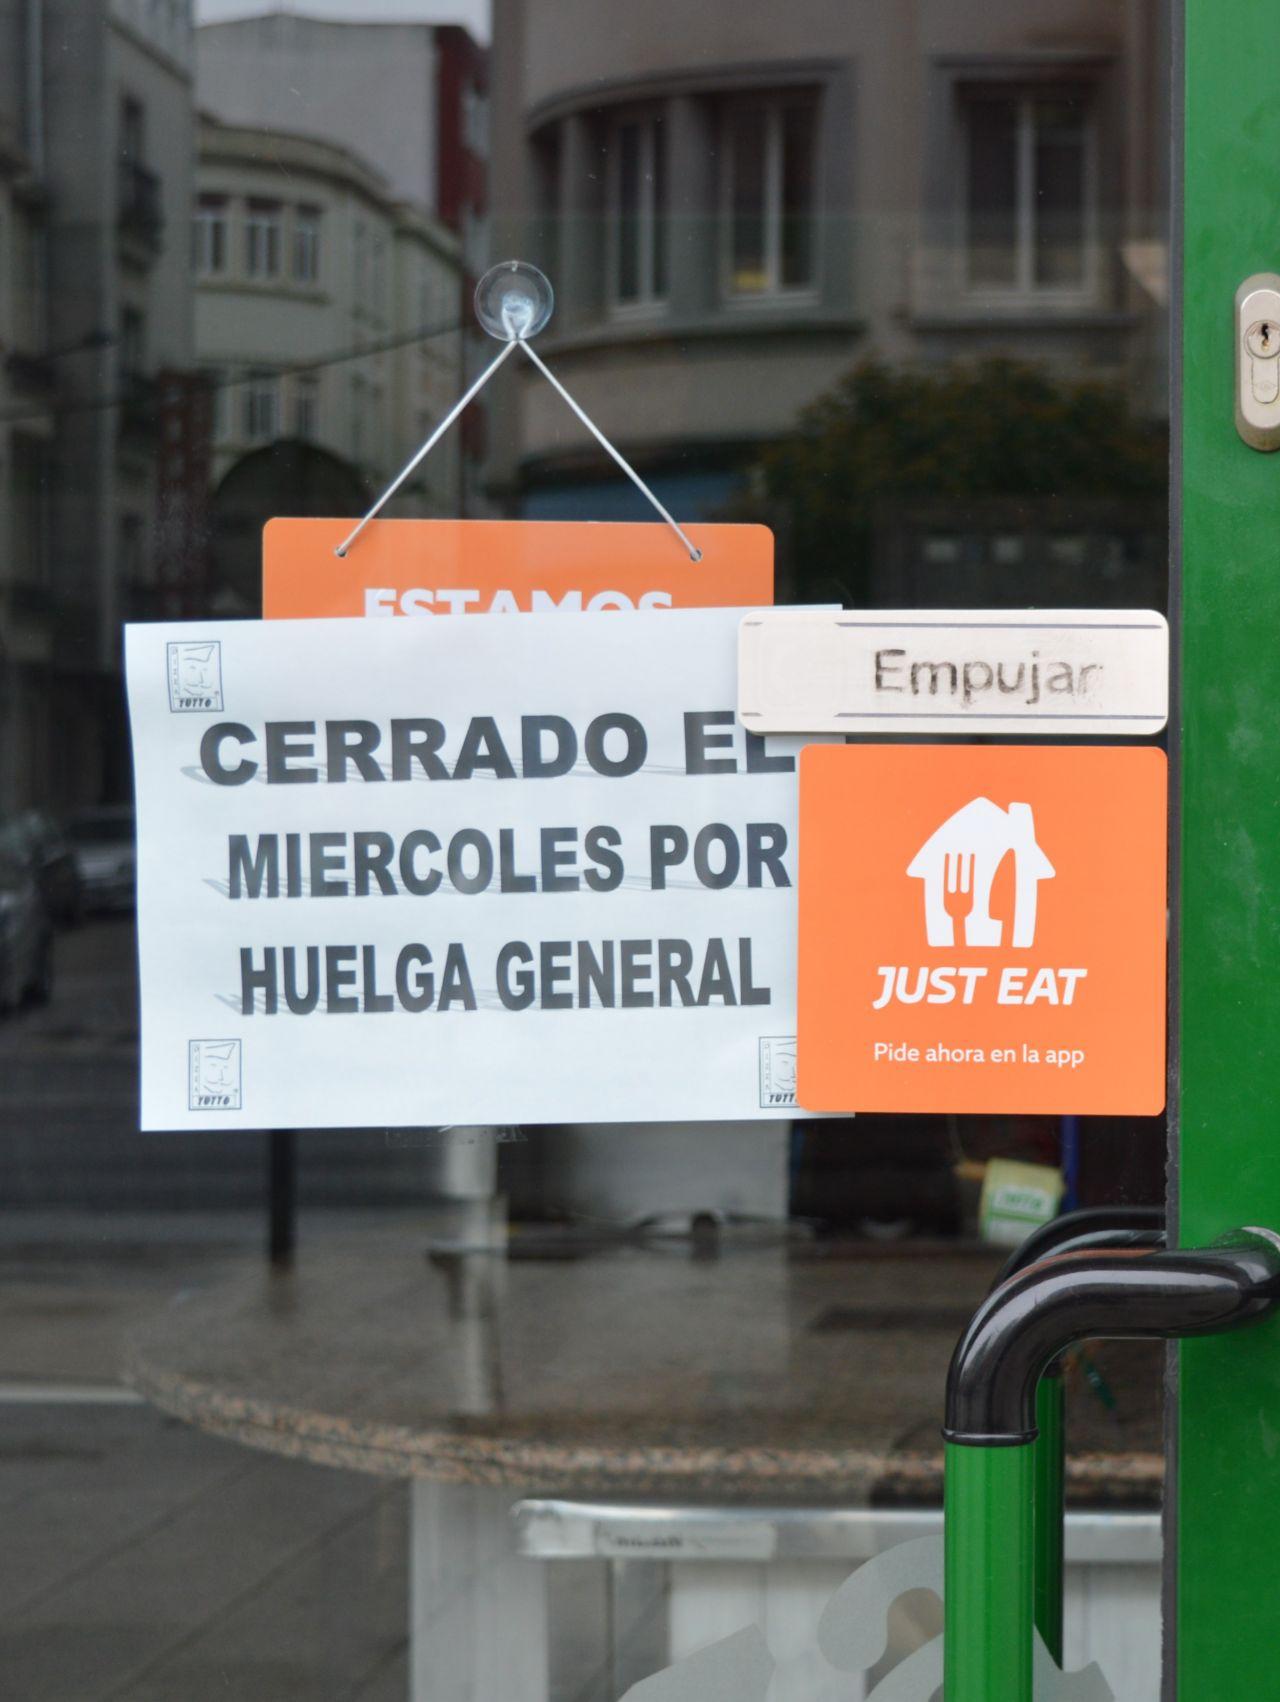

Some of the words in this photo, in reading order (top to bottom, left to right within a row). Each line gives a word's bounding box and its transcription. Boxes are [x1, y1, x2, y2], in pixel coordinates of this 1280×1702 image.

[873, 649, 1104, 705] Empujar
[200, 712, 648, 786] CERRADO
[684, 711, 796, 775] EL
[227, 825, 624, 899] MIERCOLES
[650, 822, 792, 890] POR
[239, 942, 477, 1016] HUELGA
[496, 937, 771, 1011] GENERAL
[873, 966, 987, 1010] JUST
[998, 968, 1088, 1006] EAT
[874, 1043, 919, 1062] Pide
[926, 1044, 985, 1063] ahora
[991, 1049, 1016, 1063] en
[1022, 1044, 1040, 1064] la
[1045, 1050, 1084, 1068] app
